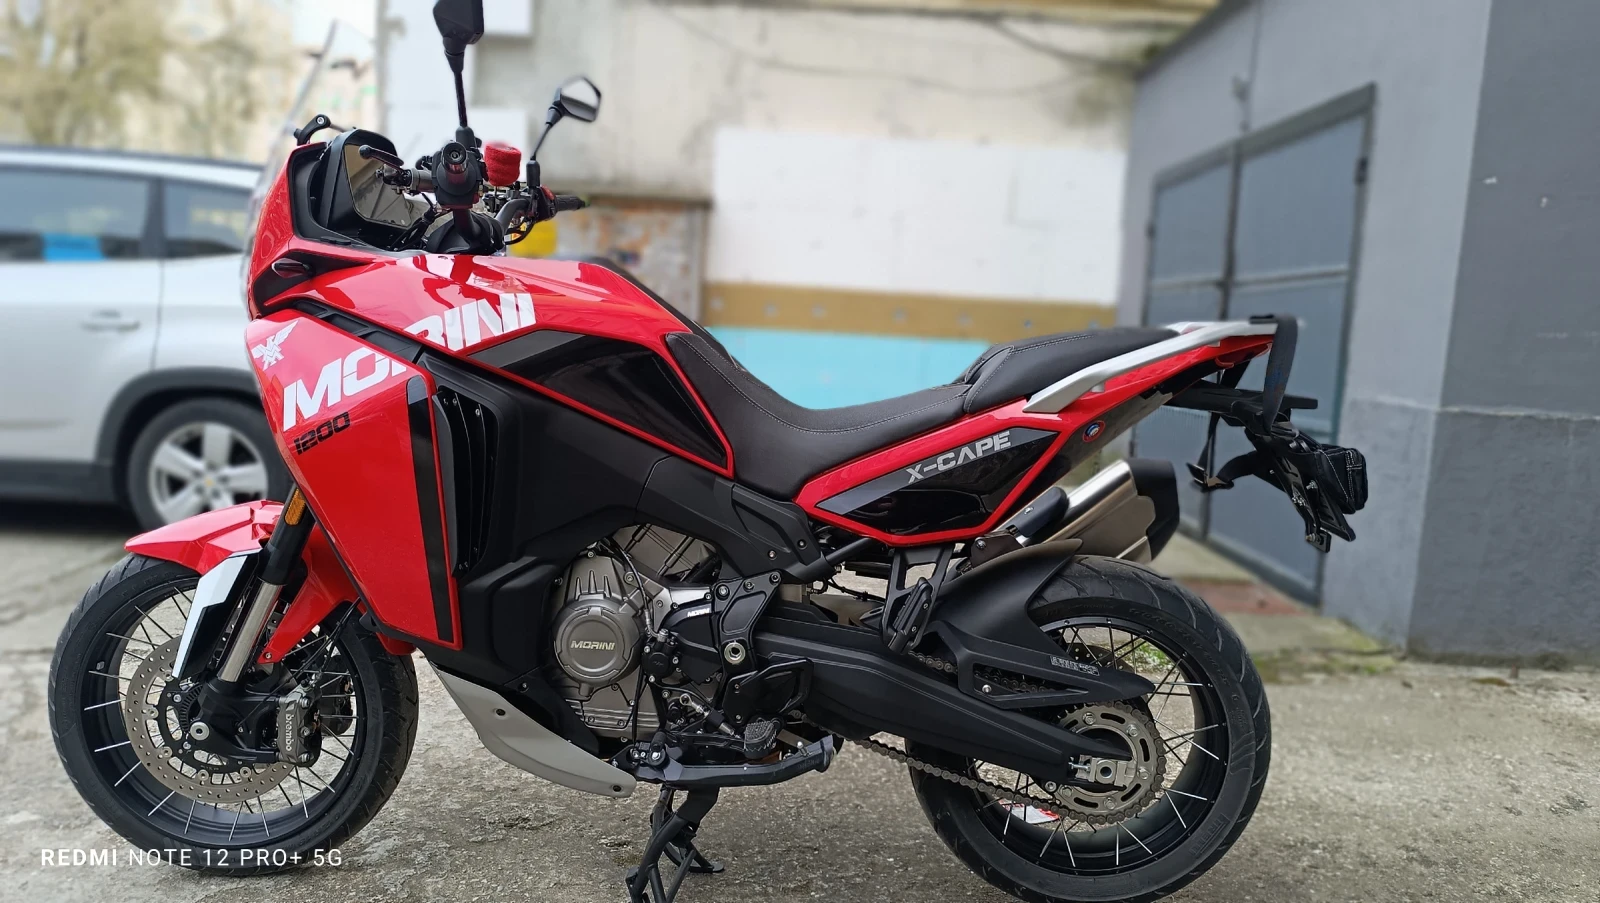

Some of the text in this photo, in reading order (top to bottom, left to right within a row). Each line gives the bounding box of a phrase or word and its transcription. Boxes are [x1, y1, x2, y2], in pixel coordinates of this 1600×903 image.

[293, 411, 351, 455] 1200
[906, 430, 1012, 484] X-CAPE
[570, 640, 616, 651] MORINI
[285, 713, 295, 752] brembo
